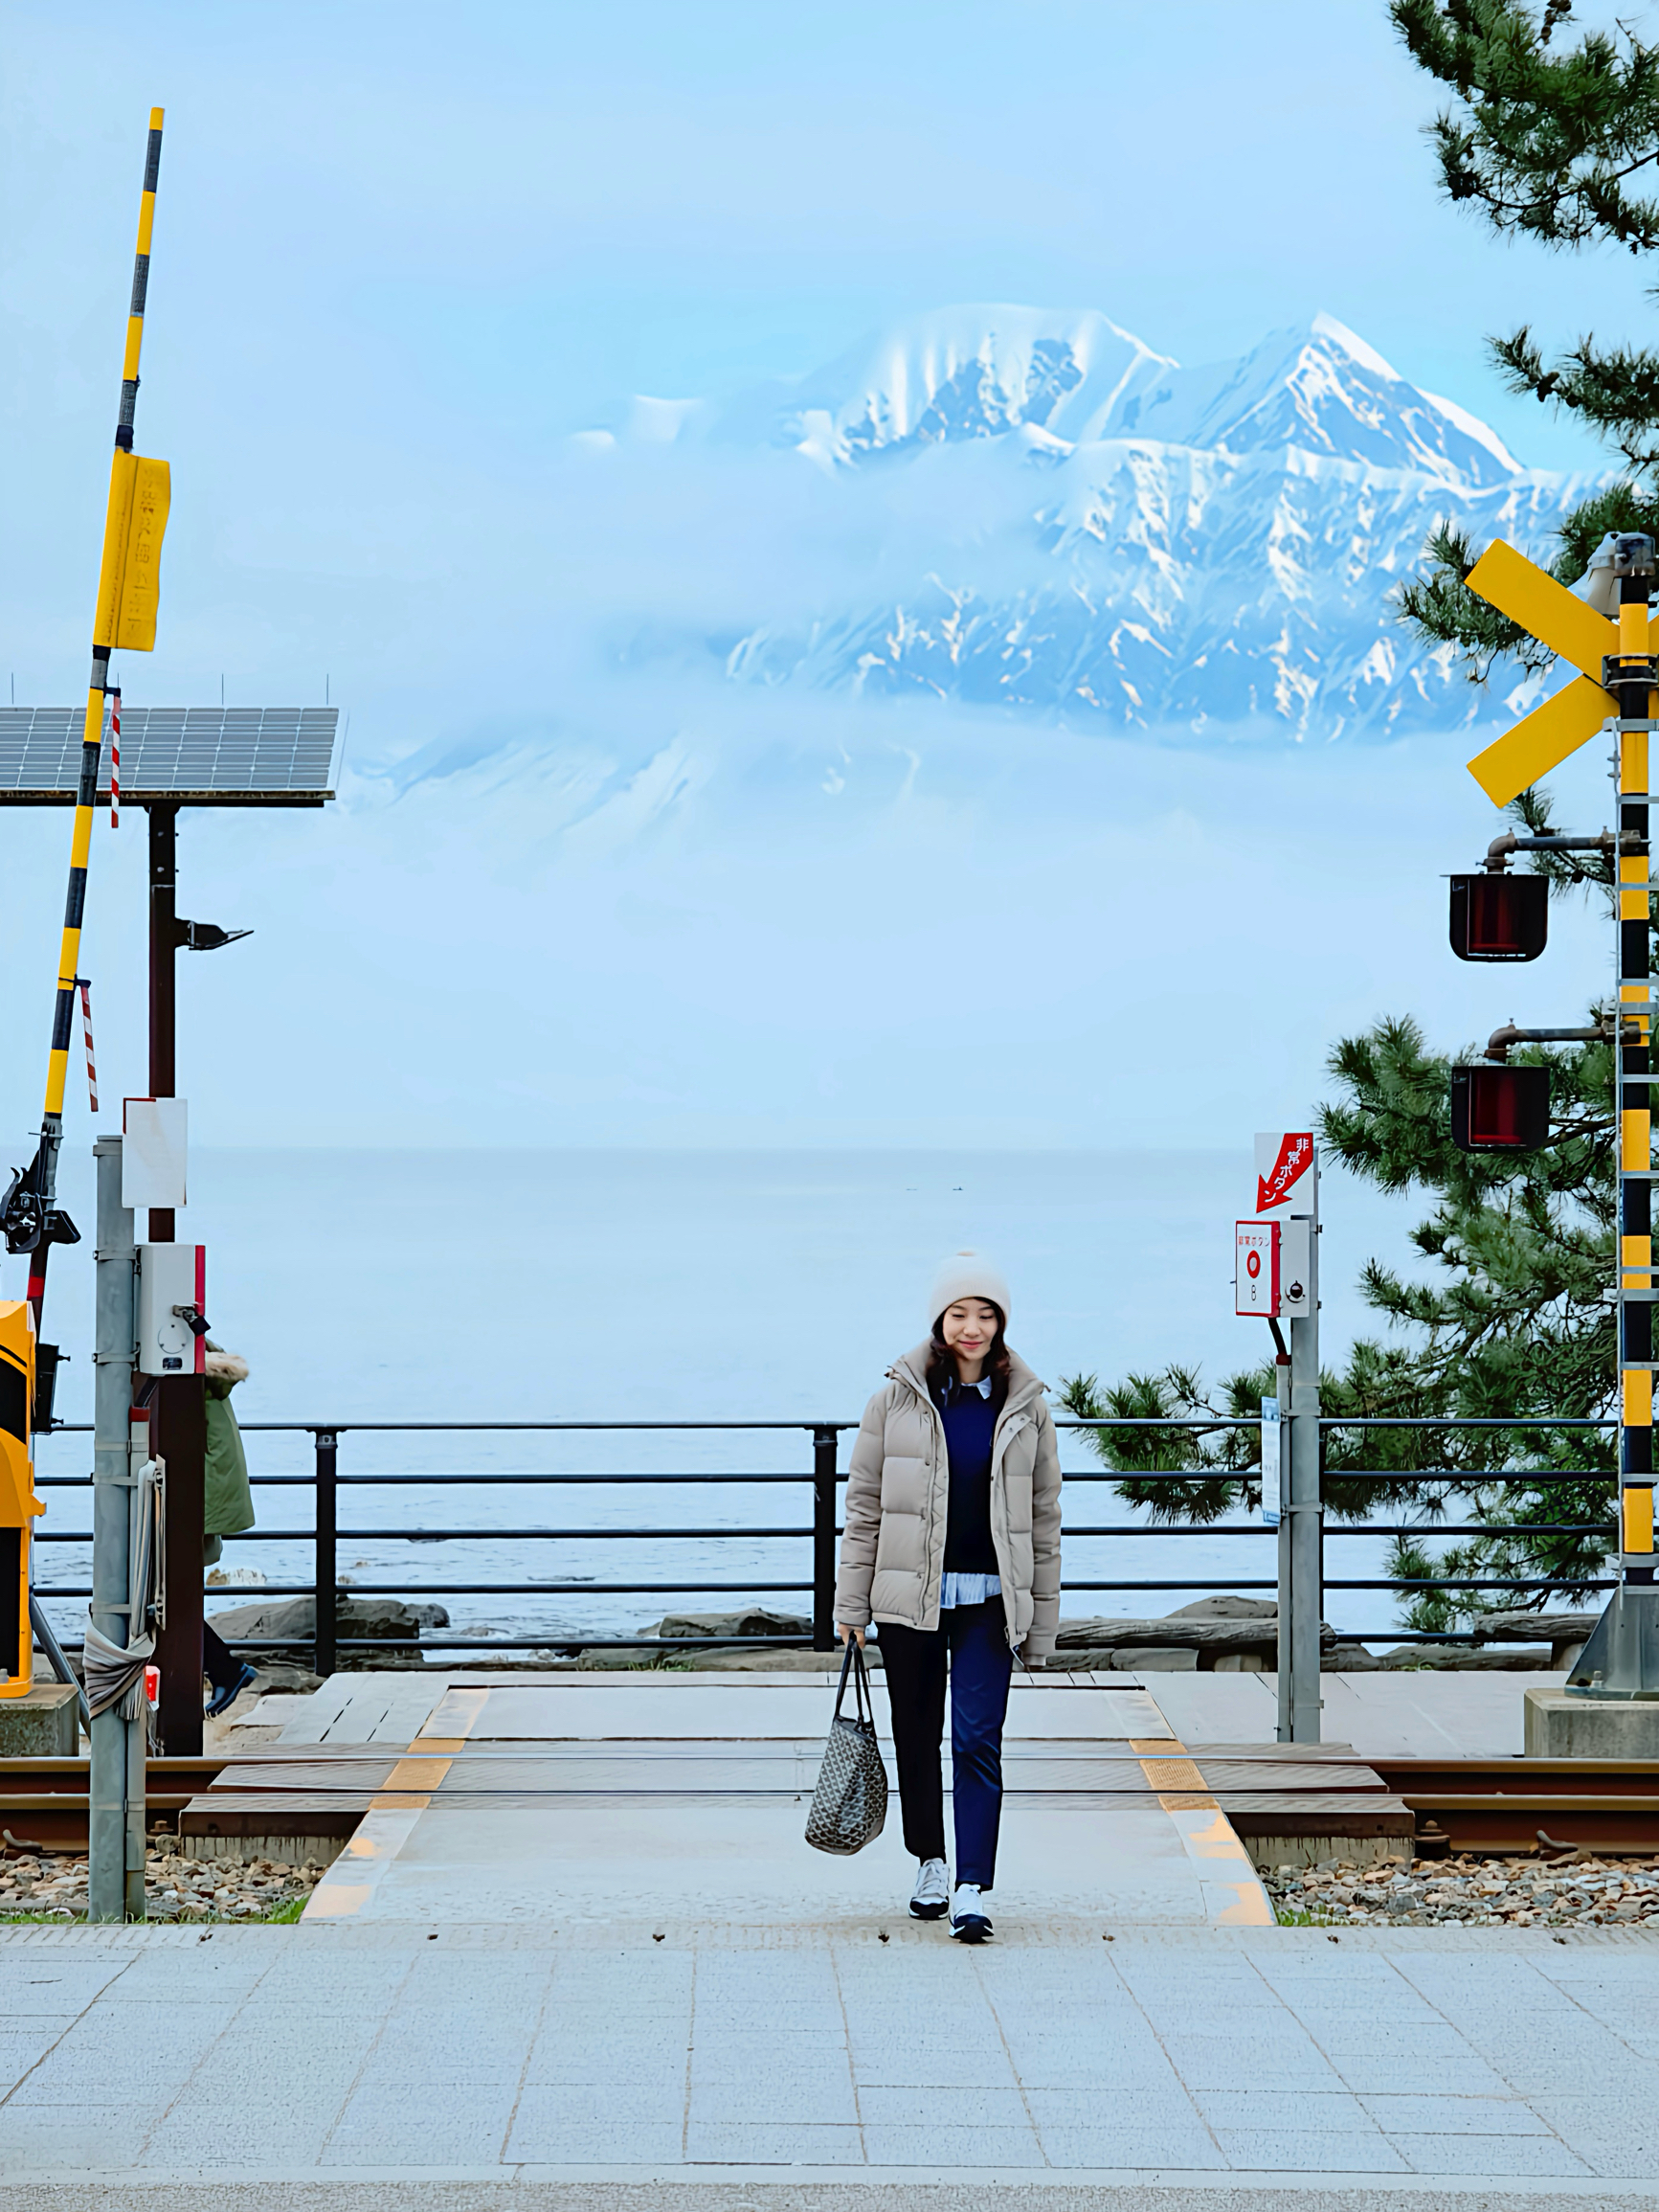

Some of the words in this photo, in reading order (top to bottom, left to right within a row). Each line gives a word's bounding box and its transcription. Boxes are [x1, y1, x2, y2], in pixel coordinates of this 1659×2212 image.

[1264, 1138, 1310, 1203] 非常ボタン
